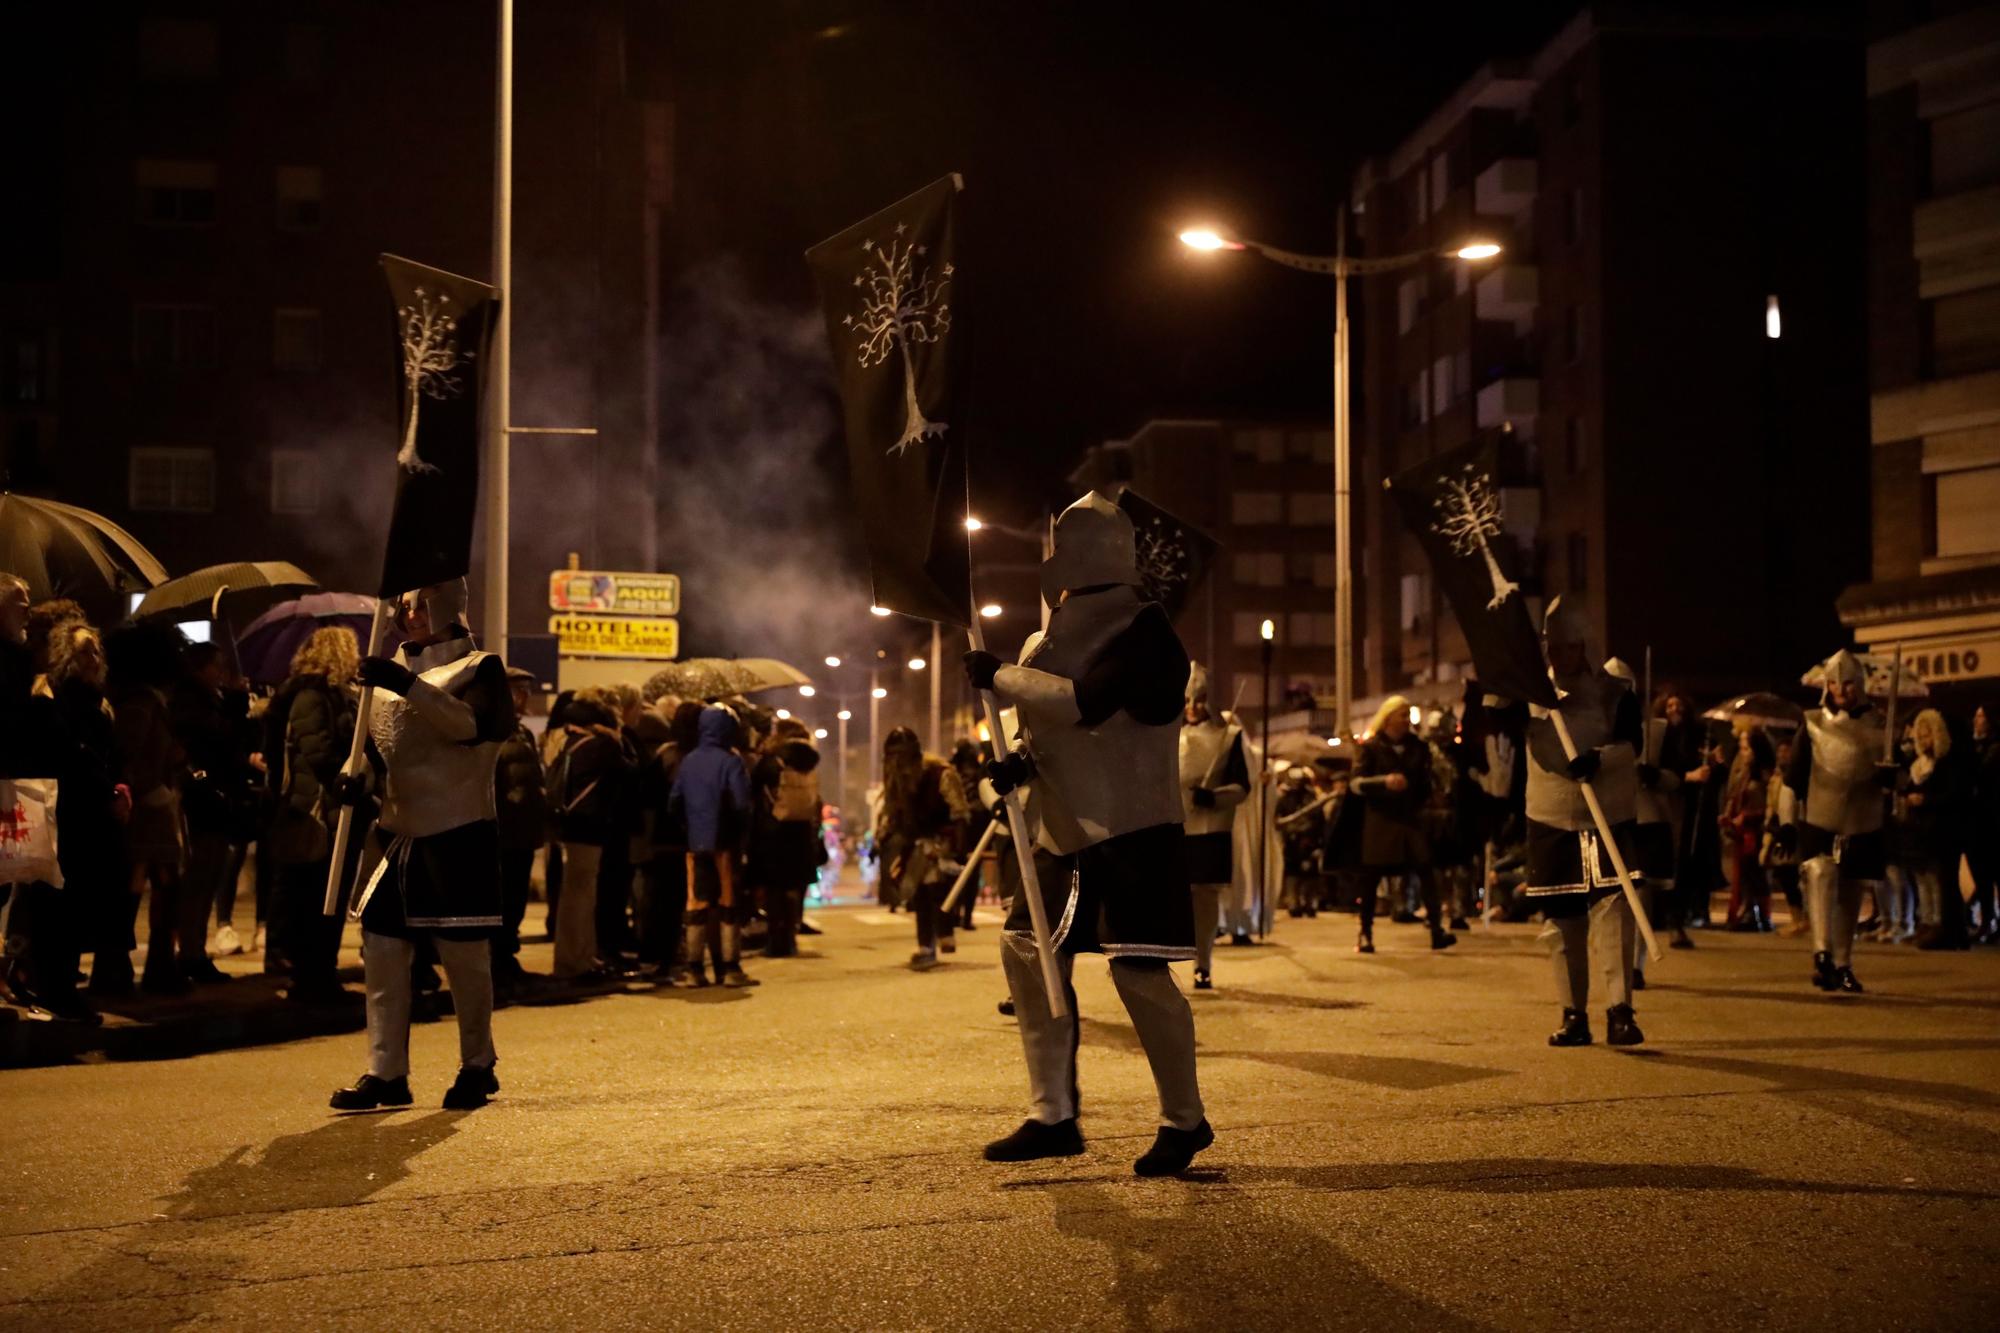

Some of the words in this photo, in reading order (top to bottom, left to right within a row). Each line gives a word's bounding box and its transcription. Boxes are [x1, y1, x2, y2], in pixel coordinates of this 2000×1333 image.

[556, 620, 635, 633] HOTEL
[600, 635, 621, 646] DEL
[625, 636, 672, 648] CAMINO
